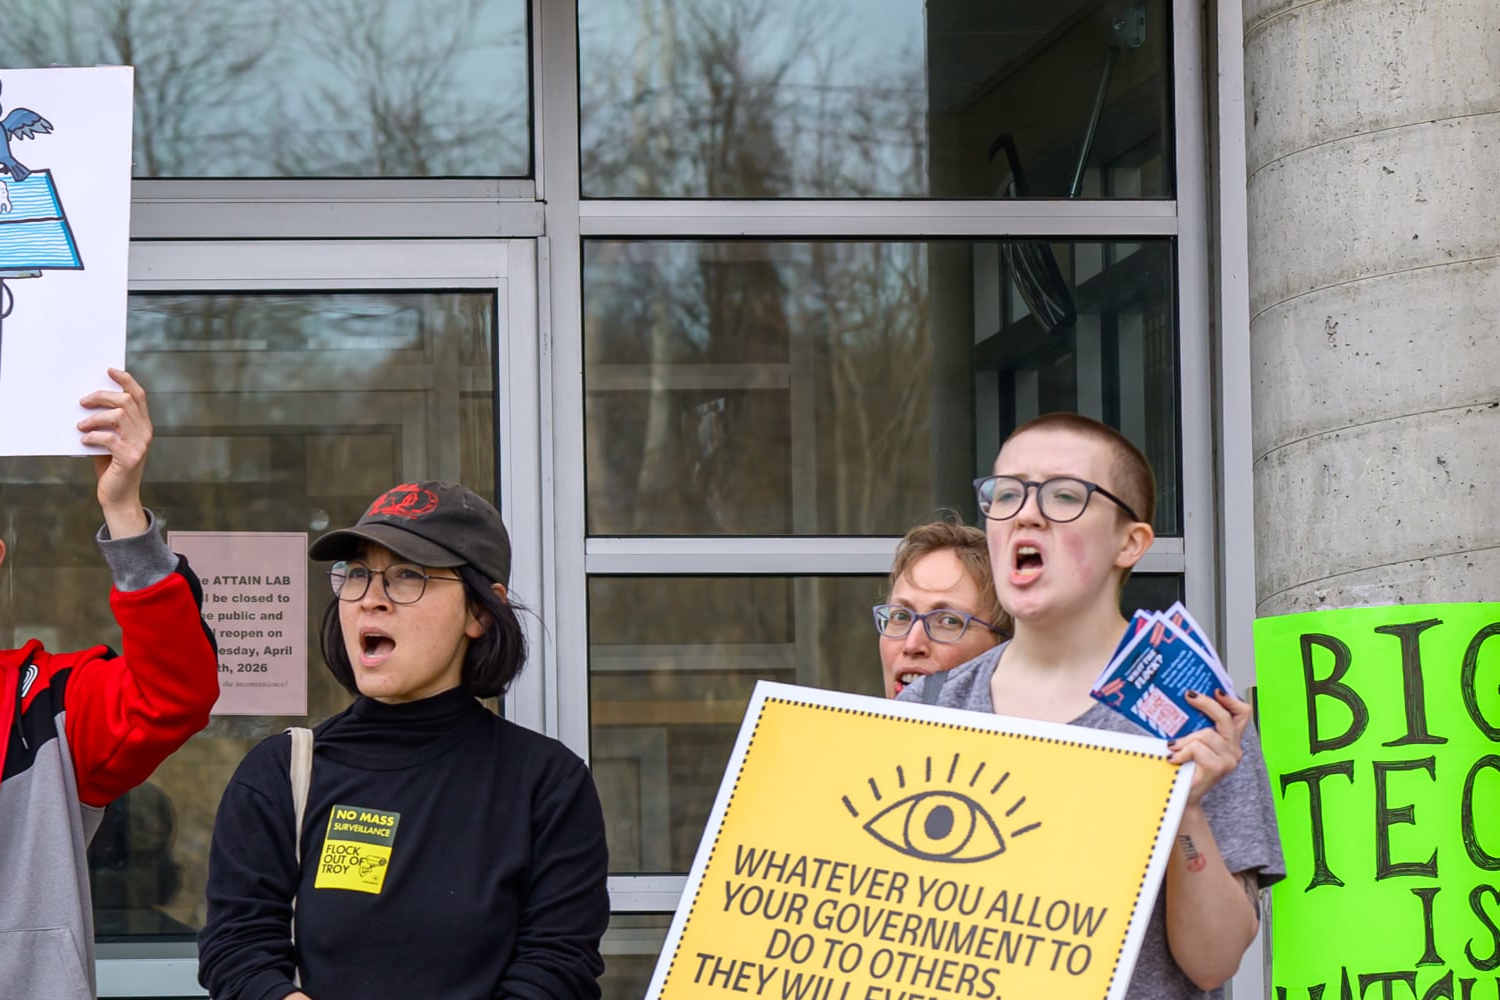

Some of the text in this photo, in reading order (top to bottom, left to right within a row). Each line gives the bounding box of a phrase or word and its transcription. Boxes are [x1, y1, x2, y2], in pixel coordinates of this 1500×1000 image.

[213, 576, 261, 585] ATTAIN
[266, 576, 291, 585] LAB
[213, 594, 228, 603] be
[232, 594, 273, 603] closed
[278, 594, 290, 603] to
[218, 611, 256, 622] public
[260, 611, 283, 620] and
[220, 630, 263, 640] reopen
[268, 630, 283, 638] on
[218, 646, 292, 657] esday, April
[218, 663, 268, 674] th, 2026
[1300, 618, 1500, 754] BIG
[336, 810, 395, 827] NO MASS
[334, 823, 390, 837] SURVEILLANCE
[326, 845, 361, 856] FLOCK
[324, 854, 364, 866] OUT OF
[322, 864, 350, 874] TROY
[734, 844, 1108, 938] WHATEVER YOU ALLOW
[723, 880, 1092, 976] YOUR GOVERNMENT TO
[1411, 884, 1500, 971] IS
[765, 928, 815, 964] DO
[823, 938, 863, 974] TO
[693, 952, 778, 995] THEY
